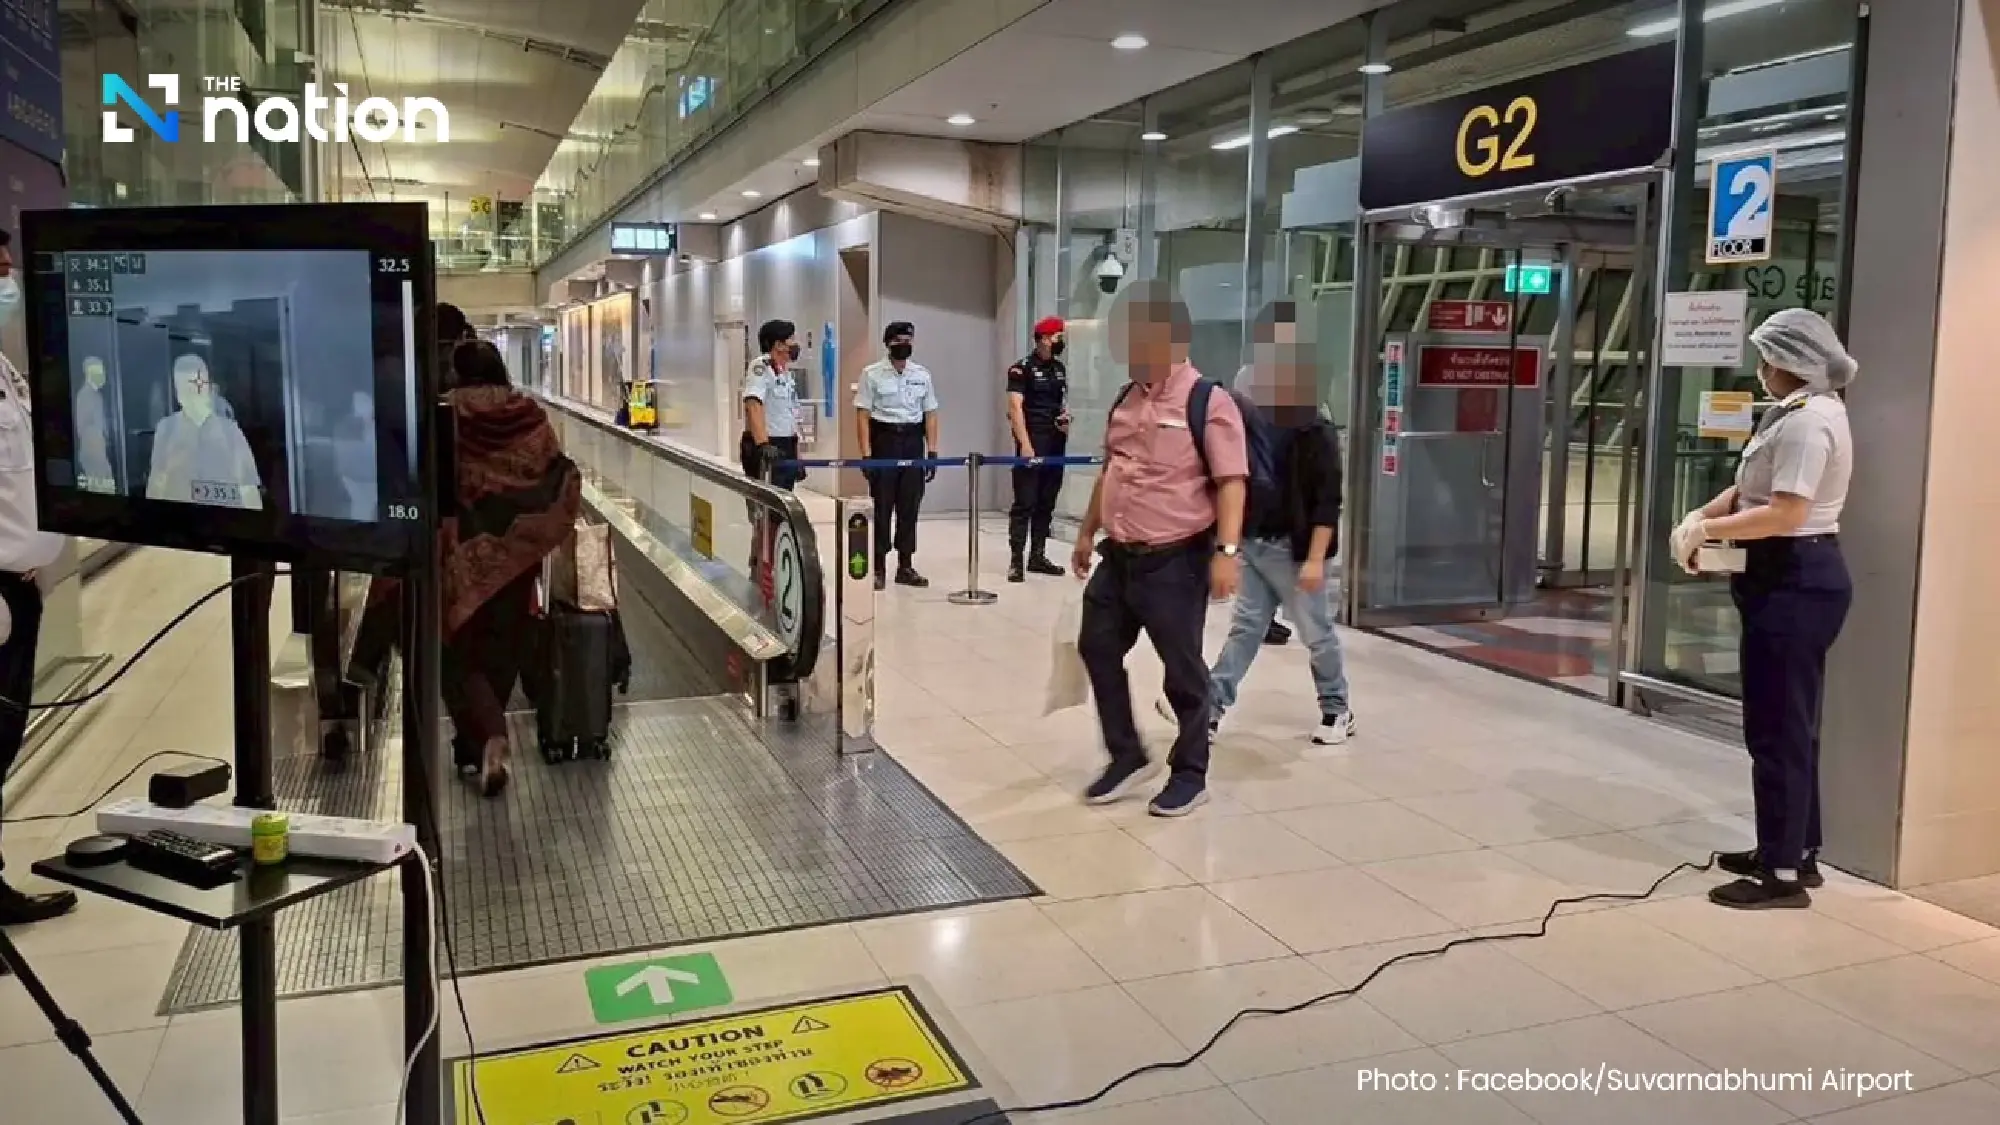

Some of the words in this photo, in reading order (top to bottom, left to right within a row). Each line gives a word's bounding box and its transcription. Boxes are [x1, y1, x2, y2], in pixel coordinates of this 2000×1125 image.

[1456, 95, 1537, 177] G2
[1729, 165, 1770, 236] 2
[379, 258, 410, 272] 32.5
[1711, 239, 1752, 257] FLOOR
[388, 505, 418, 520] 18.0
[617, 1057, 681, 1075] WATCH
[688, 1047, 737, 1062] YOUR
[743, 1039, 783, 1054] STEP
[626, 1024, 764, 1058] CAUTION
